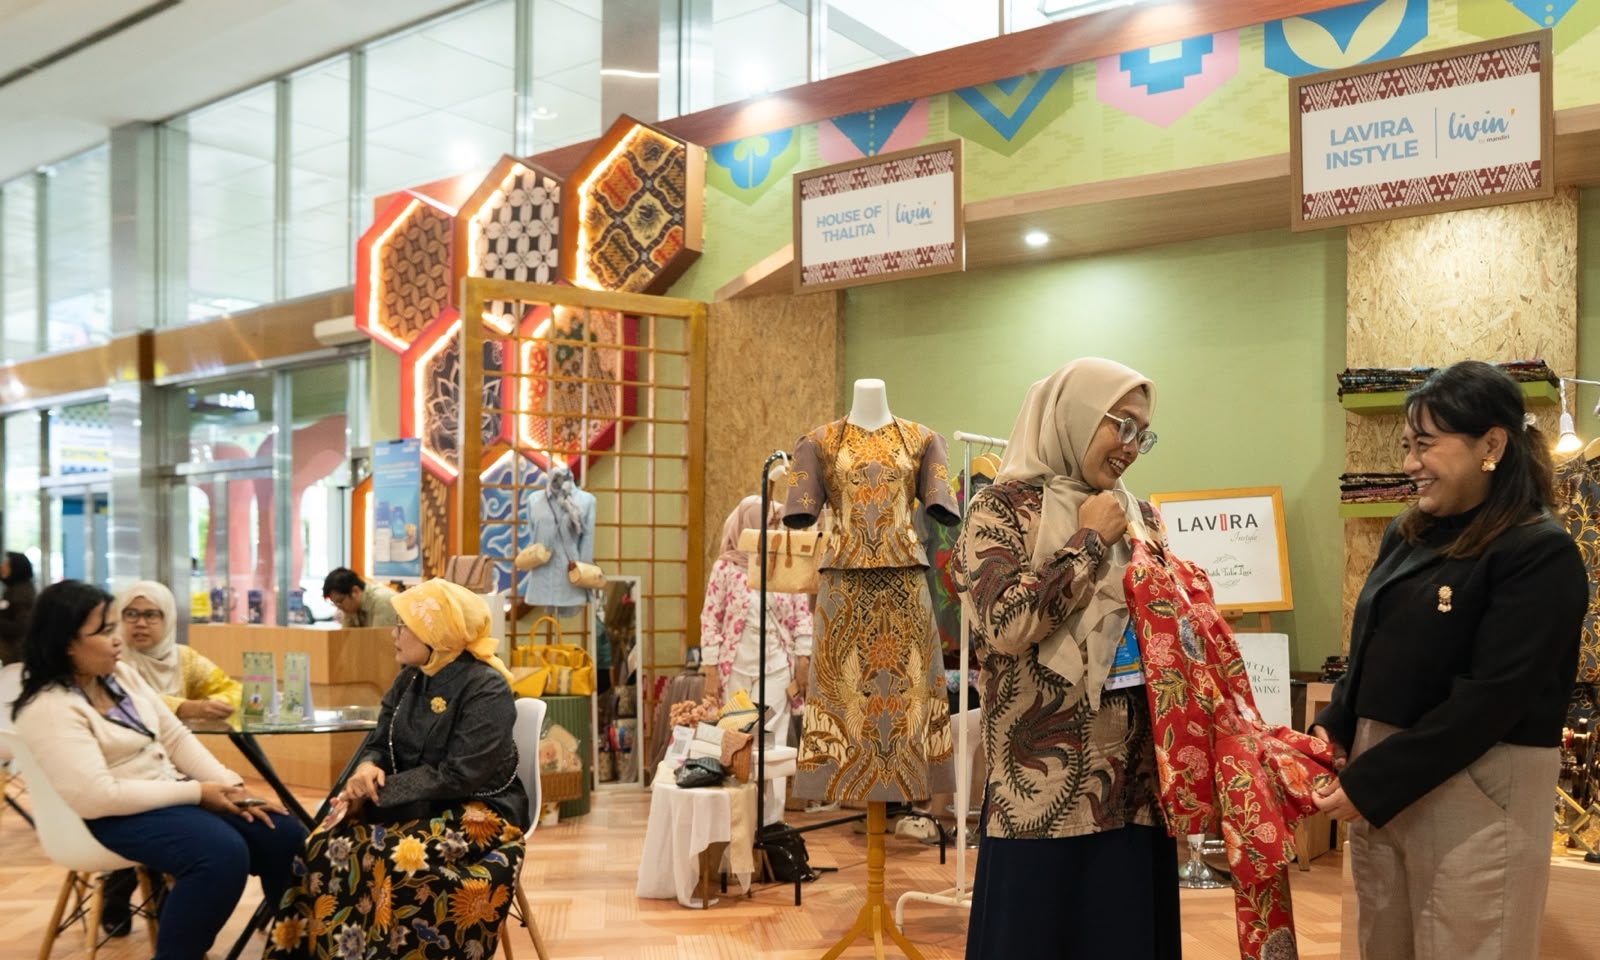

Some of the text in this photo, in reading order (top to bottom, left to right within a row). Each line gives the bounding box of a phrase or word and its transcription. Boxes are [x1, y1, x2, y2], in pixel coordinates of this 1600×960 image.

[1330, 117, 1414, 146] LAVIRA
[1326, 139, 1419, 170] INSTYLE
[816, 205, 882, 228] HOUSE OF
[822, 223, 876, 242] THALITA
[1178, 513, 1258, 532] LAVIRA
